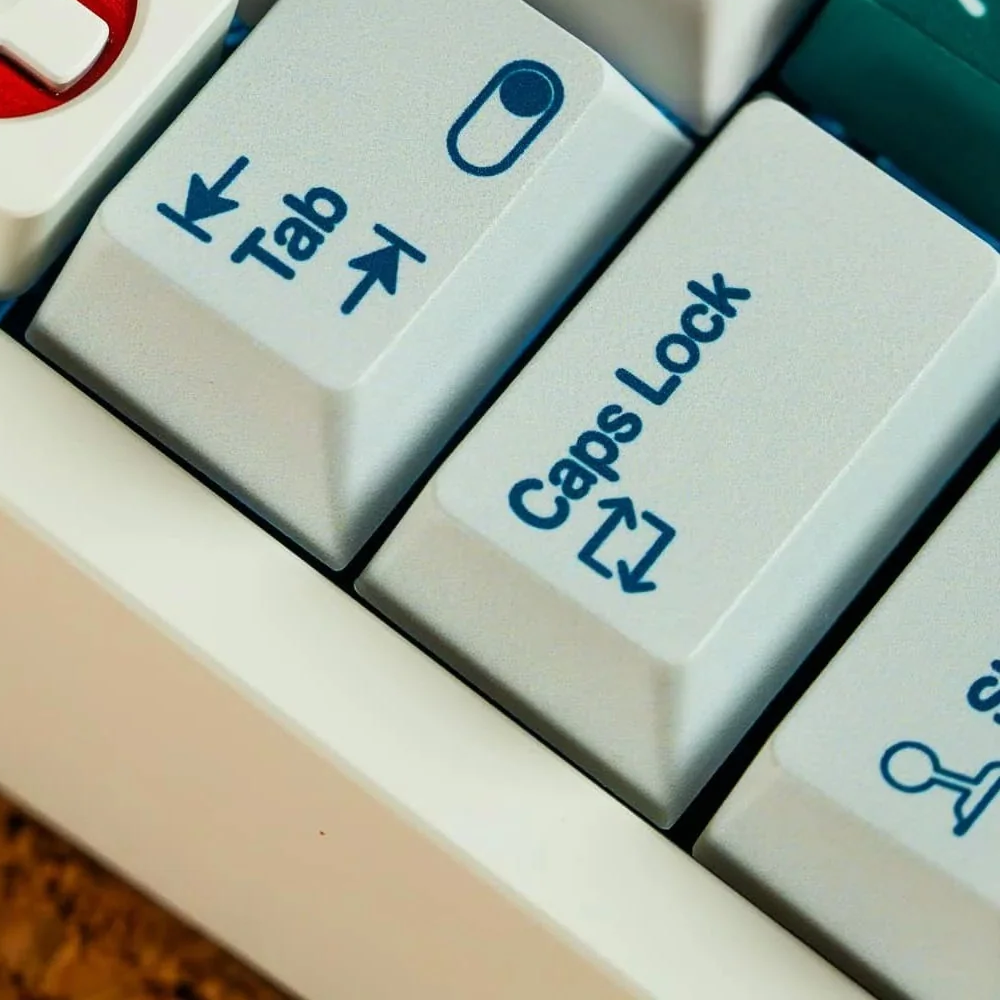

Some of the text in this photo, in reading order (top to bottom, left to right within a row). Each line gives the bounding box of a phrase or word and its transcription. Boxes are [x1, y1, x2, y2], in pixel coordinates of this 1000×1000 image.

[230, 186, 348, 281] Tab
[507, 272, 752, 531] Caps Lock
